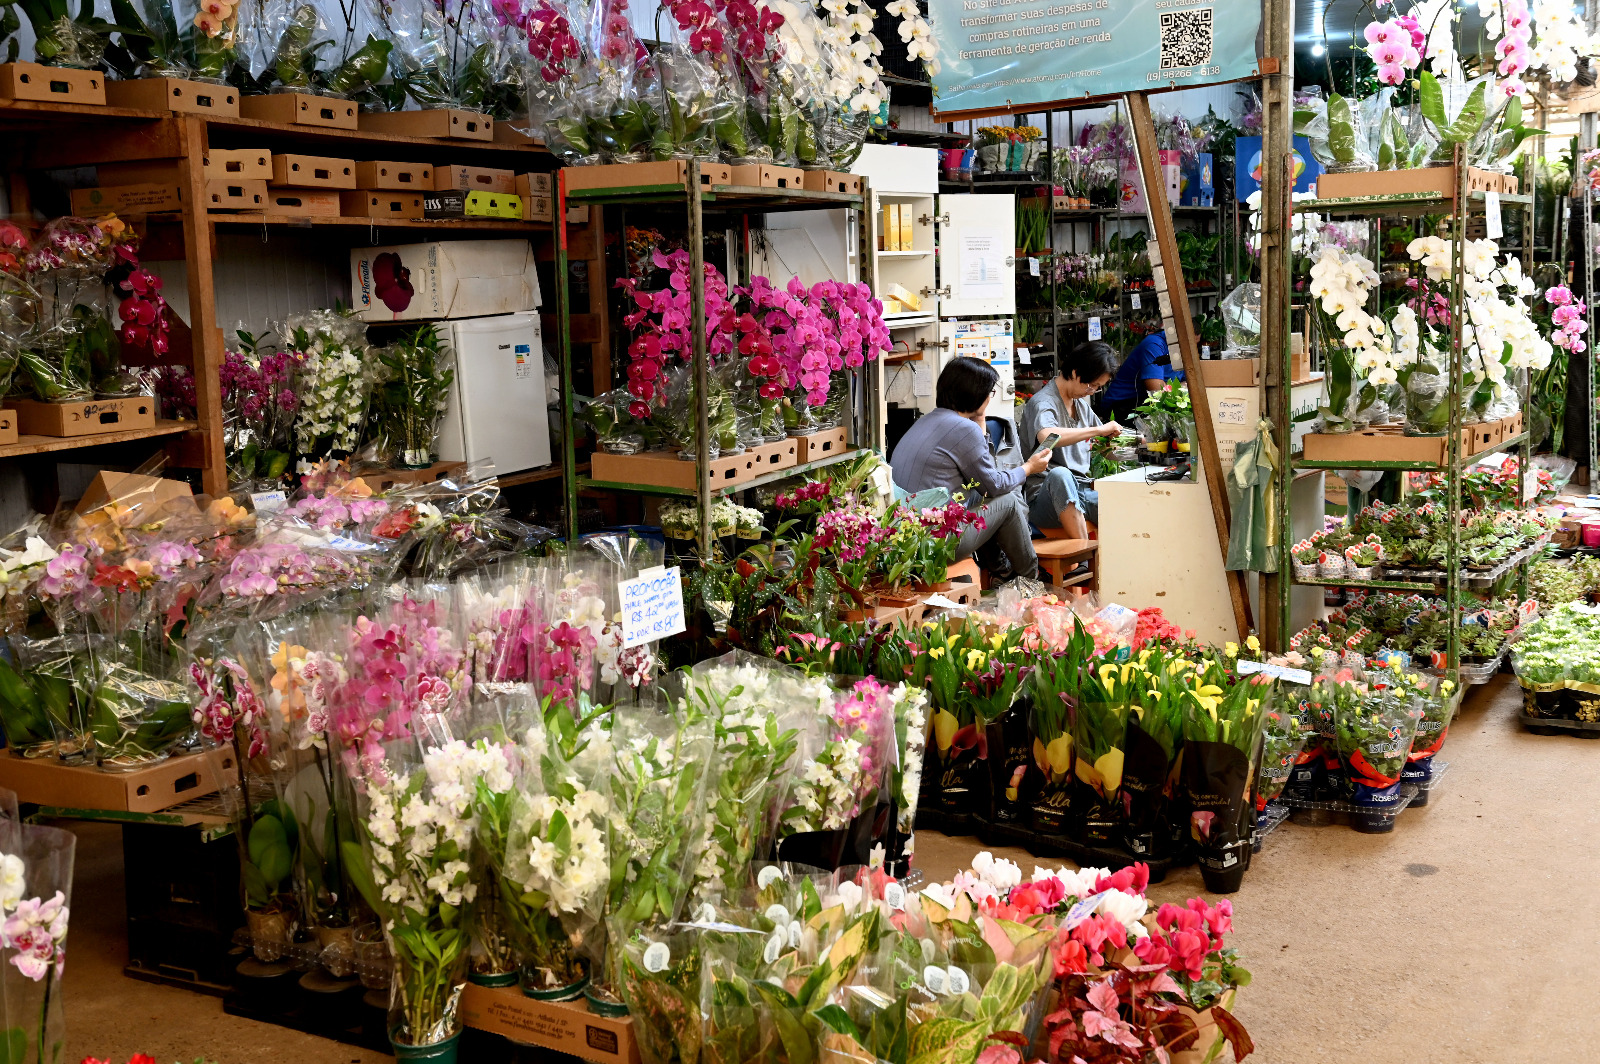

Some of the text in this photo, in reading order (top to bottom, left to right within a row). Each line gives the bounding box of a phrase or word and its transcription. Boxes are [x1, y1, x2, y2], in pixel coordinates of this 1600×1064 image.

[964, 0, 978, 10] No
[980, 0, 998, 8] site
[1156, 1, 1172, 9] seu
[961, 0, 1108, 27] transformar suas despesas de
[969, 17, 1101, 43] compras rotineiras em uma
[959, 32, 1112, 60] ferramenta de geração de renda
[1146, 70, 1161, 82] (19)
[1163, 69, 1192, 79] 98266
[1200, 66, 1220, 76] 6138
[627, 631, 634, 641] 2
